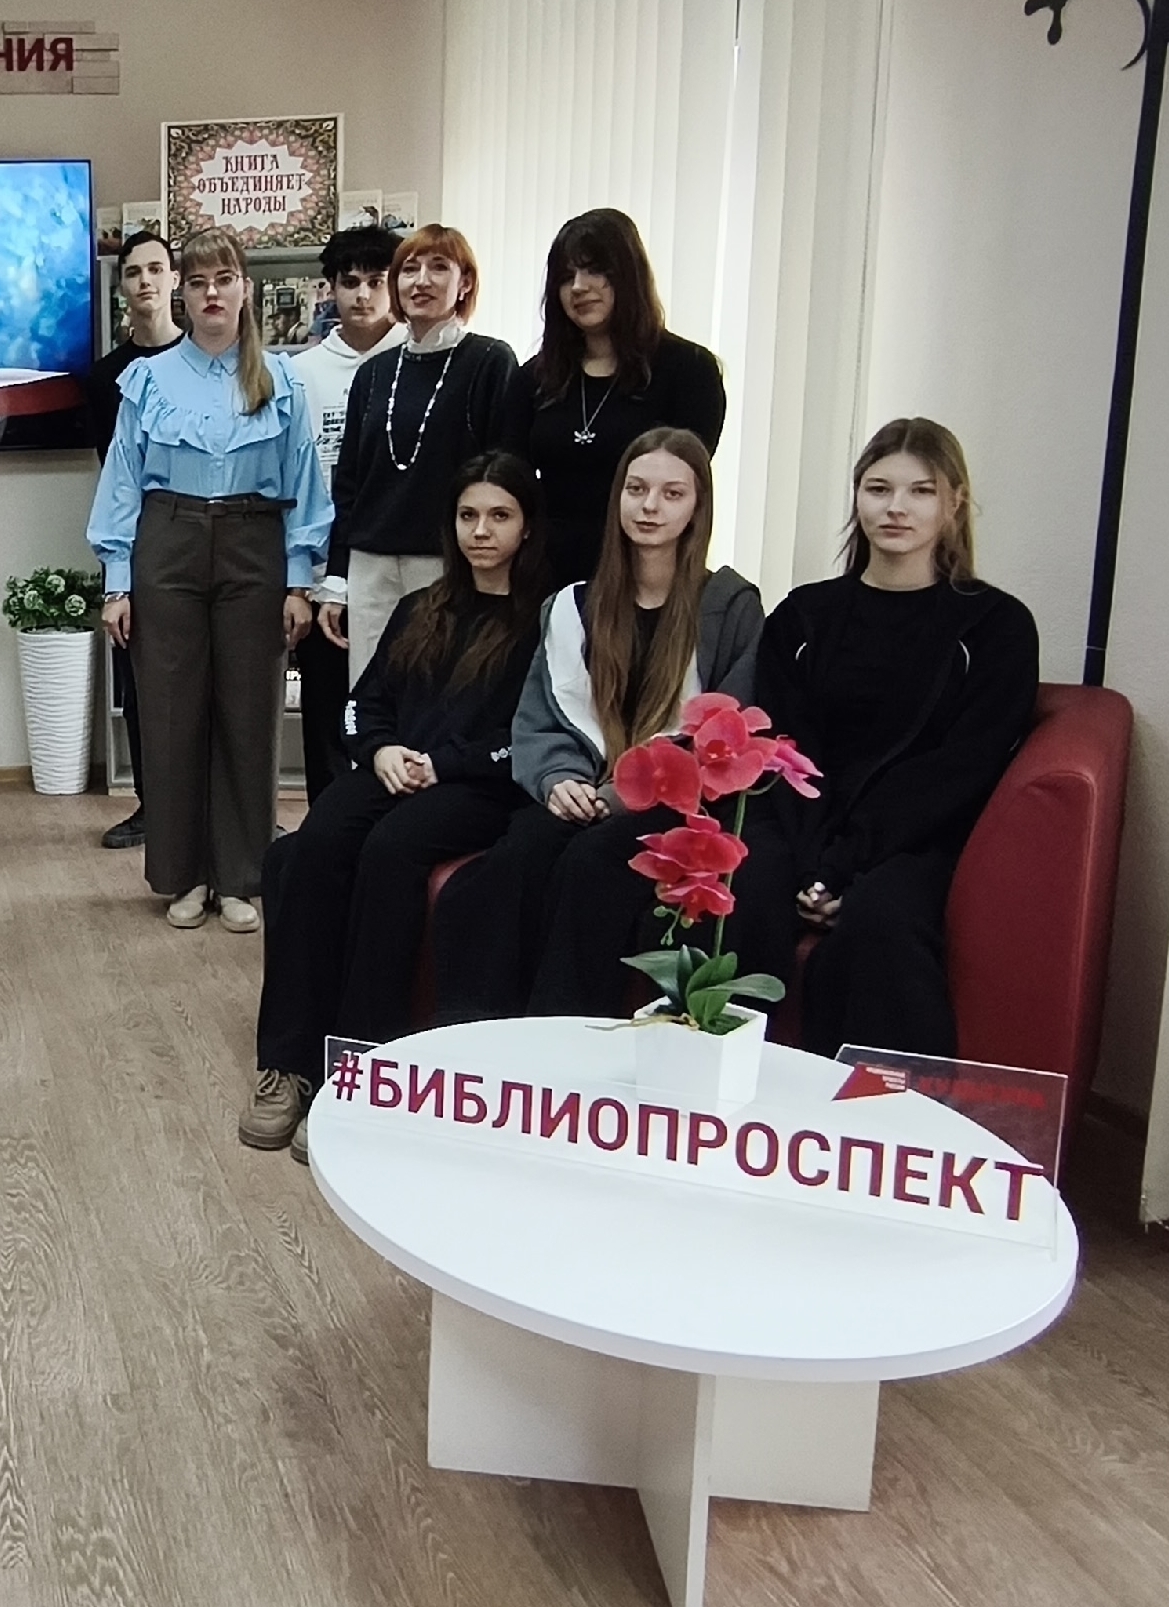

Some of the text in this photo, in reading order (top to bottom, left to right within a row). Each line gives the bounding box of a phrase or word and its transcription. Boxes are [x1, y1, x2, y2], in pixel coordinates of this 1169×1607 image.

[222, 154, 280, 174] КНИГА
[197, 173, 305, 195] ОБЪЕДИНЯЕТ
[220, 195, 286, 216] НАРОДЫ
[332, 1050, 1044, 1221] #БИБЛИОПРОСПЕКТ
